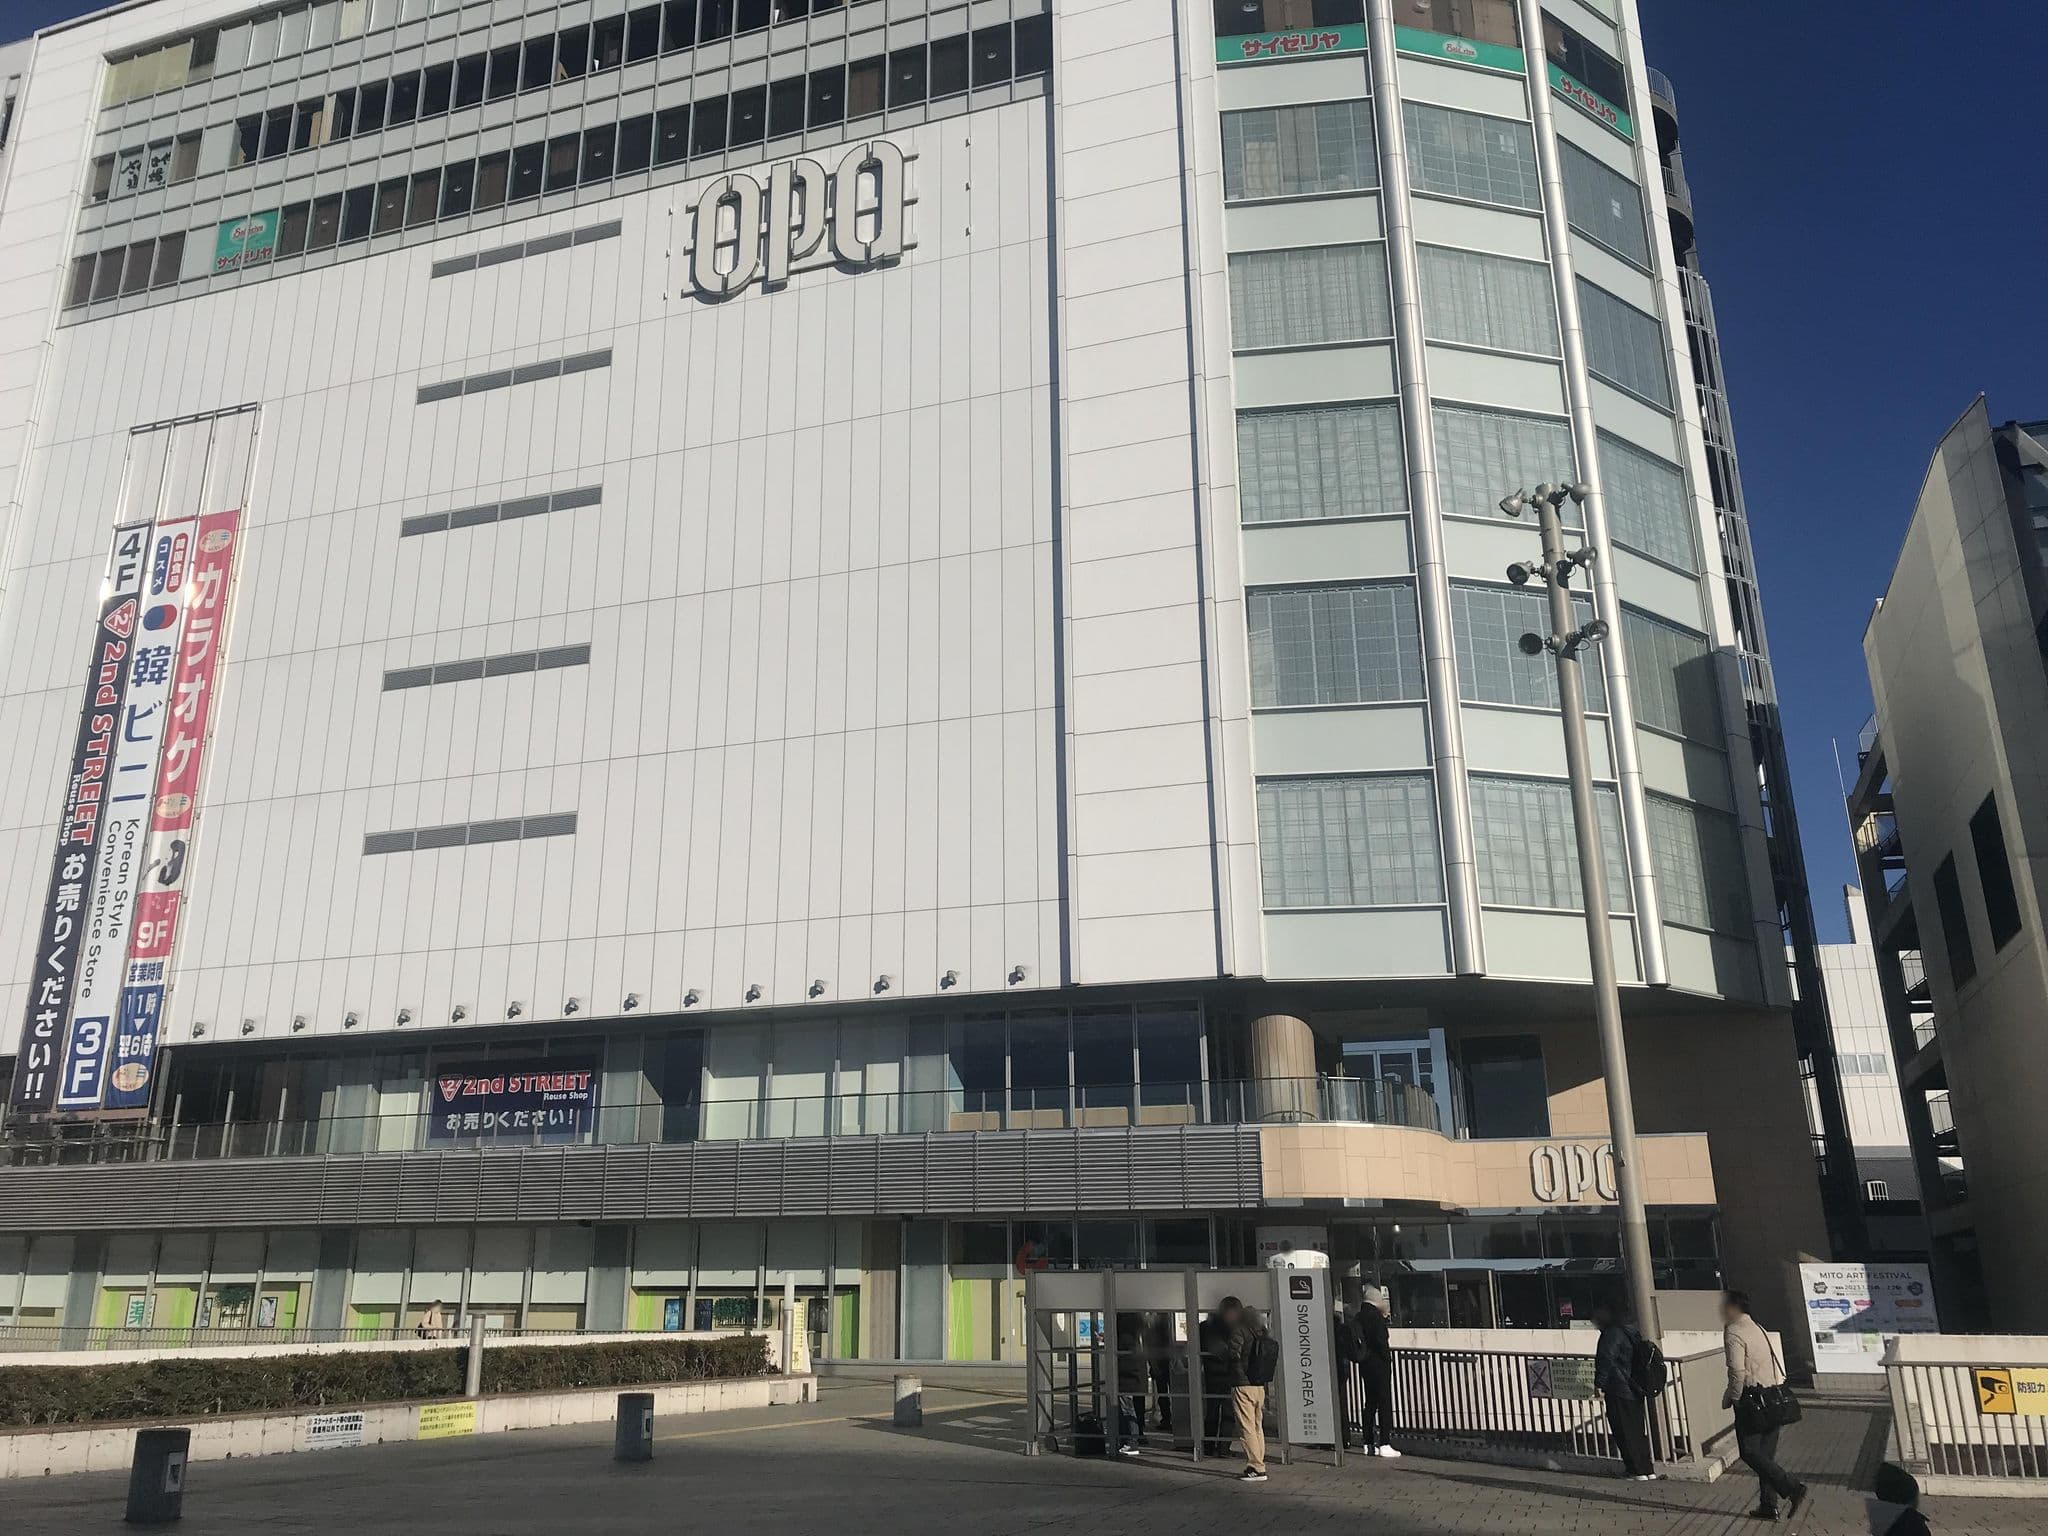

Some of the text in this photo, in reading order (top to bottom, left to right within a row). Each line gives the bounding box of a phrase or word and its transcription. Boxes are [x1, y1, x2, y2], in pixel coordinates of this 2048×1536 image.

[1242, 33, 1340, 57] サイゼリヤ
[1560, 76, 1617, 124] サイゼリヤ
[153, 543, 169, 588] コスメ
[167, 562, 223, 783] カラオケ
[70, 641, 126, 846] 2nd STREET
[59, 774, 81, 847] Reuse Shop
[108, 818, 141, 939] Korean Style
[81, 820, 122, 999] Convenience Store
[136, 920, 169, 950] 9F
[128, 961, 165, 983] 営業時間
[71, 1021, 103, 1094] 3F
[119, 1033, 153, 1058] 翌6時
[462, 1070, 592, 1096] 2nd STREET
[543, 1091, 588, 1101] Reuse Shop
[1820, 1272, 1844, 1280] MITO
[1846, 1272, 1865, 1280] ART
[1296, 1303, 1312, 1368] SMOKING
[1301, 1370, 1314, 1407] AREA
